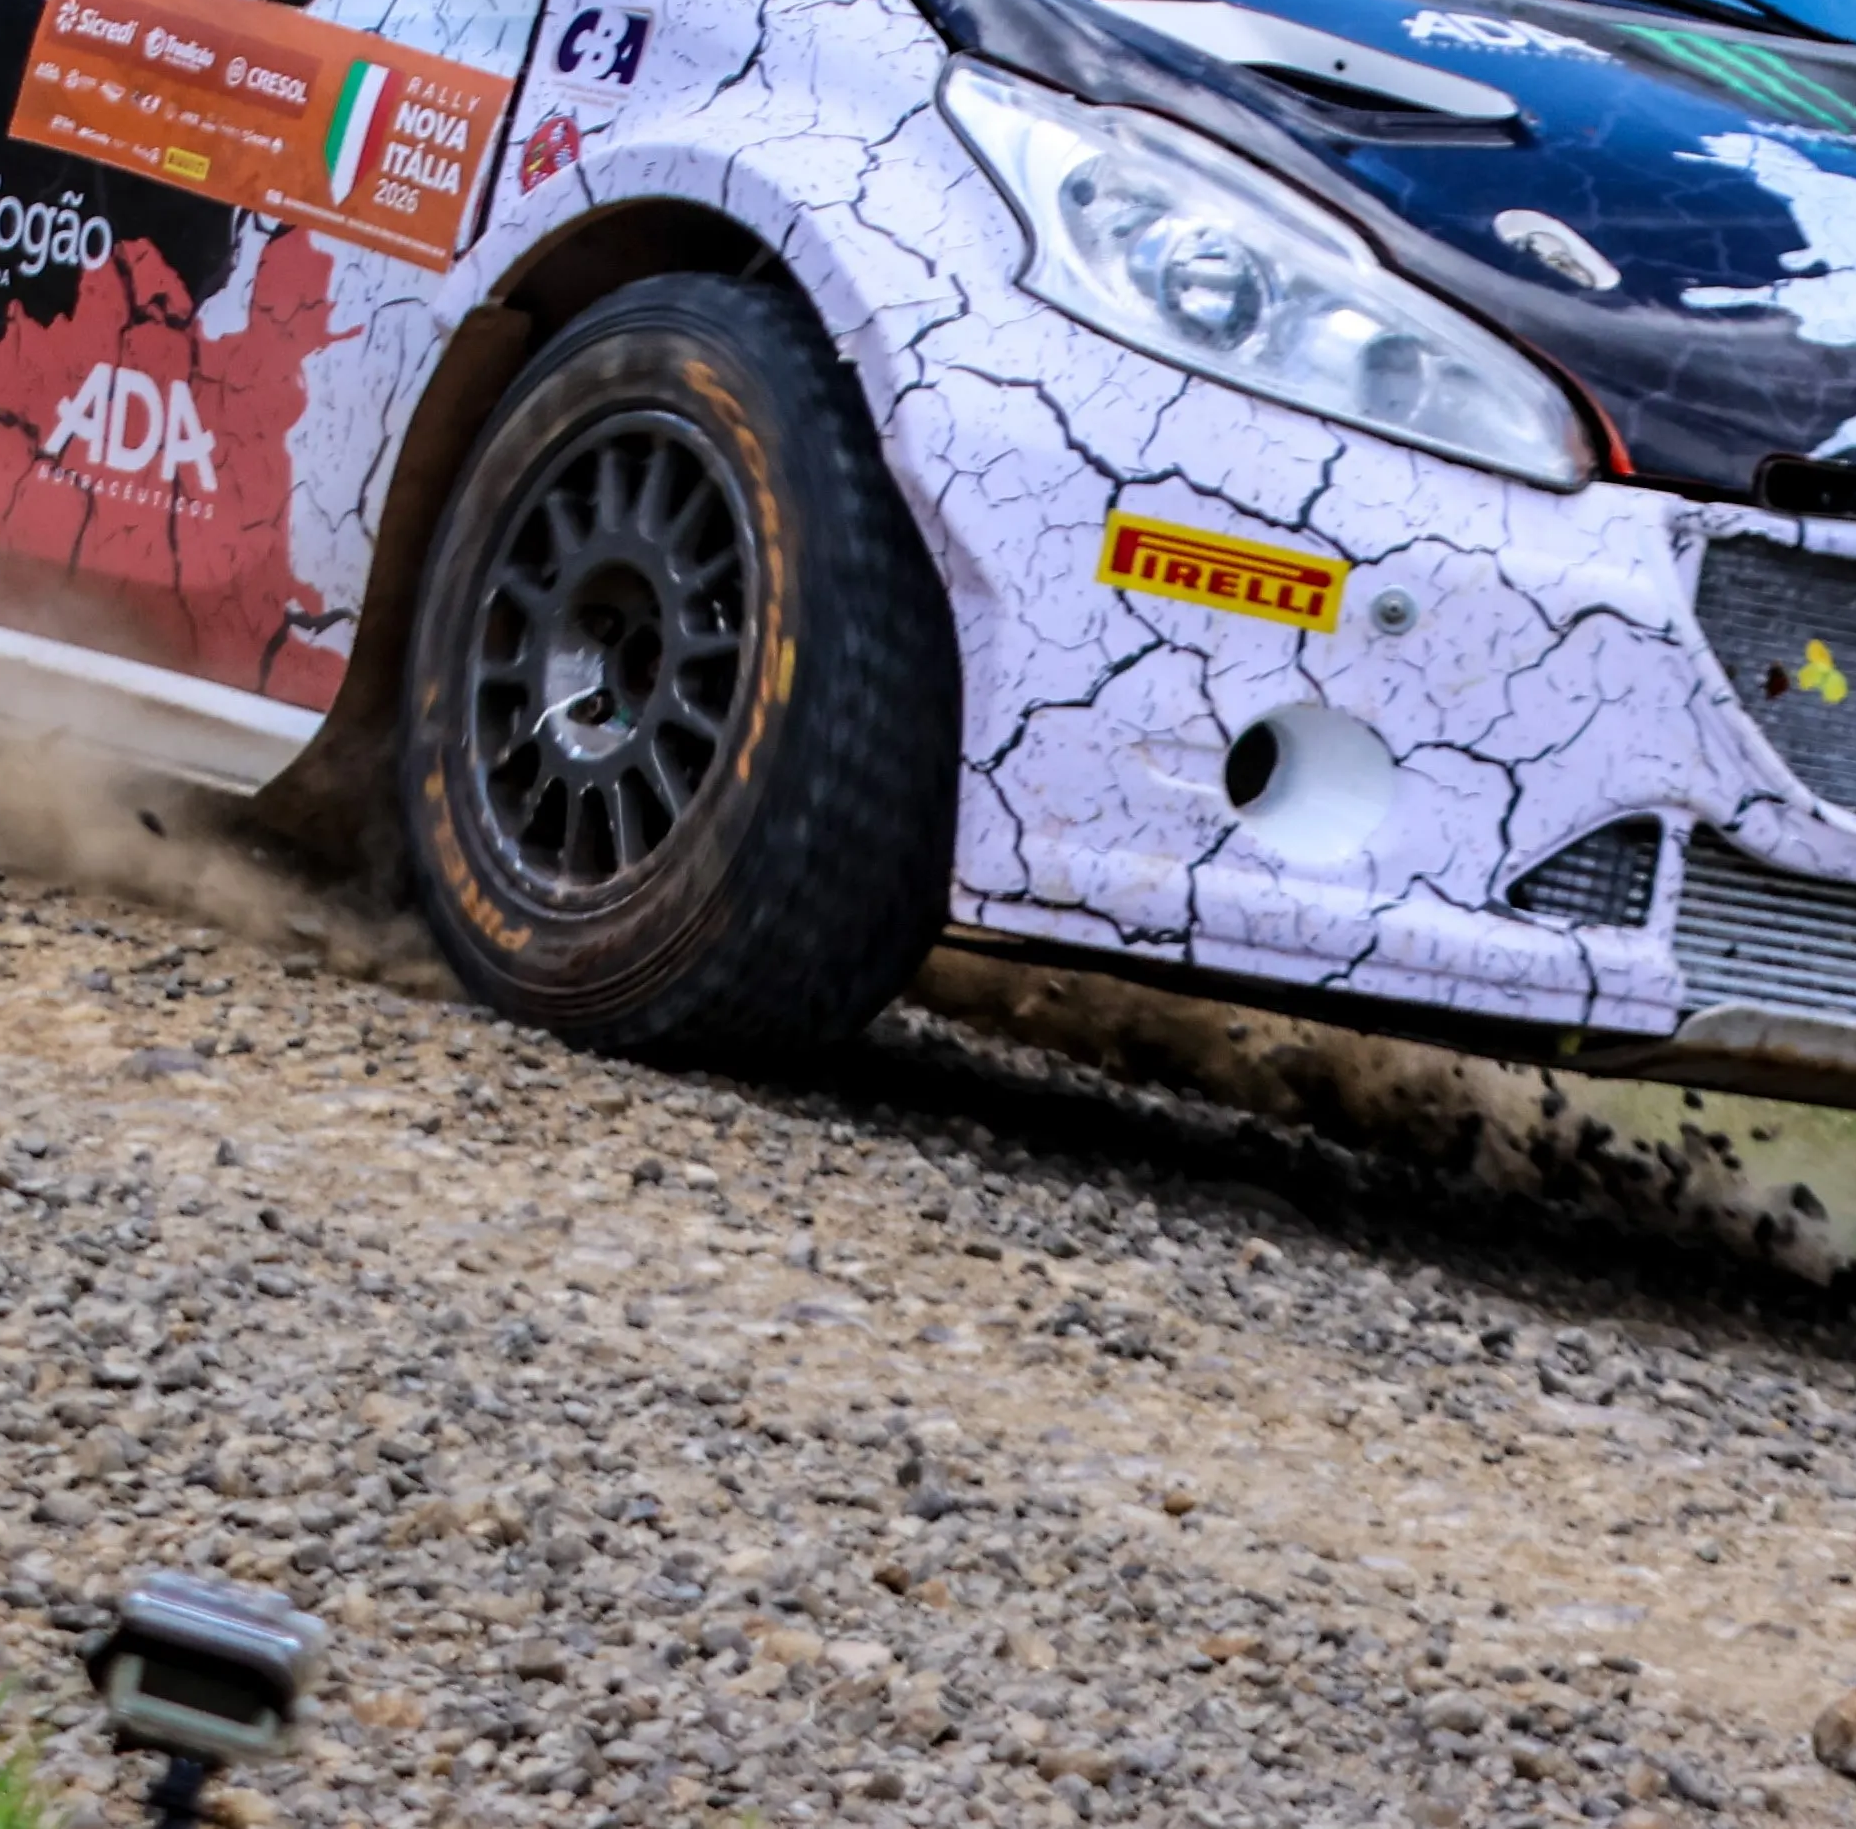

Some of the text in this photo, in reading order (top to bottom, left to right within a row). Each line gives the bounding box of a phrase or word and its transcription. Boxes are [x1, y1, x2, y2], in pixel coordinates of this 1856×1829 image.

[76, 8, 139, 47] Sicredi
[1400, 9, 1612, 58] ADA
[247, 66, 309, 105] CRESOL
[406, 76, 481, 113] RALLY
[394, 100, 470, 153] NOVA
[381, 141, 462, 196] ITÁLIA
[373, 178, 421, 215] 2026
[43, 361, 219, 493] ADA
[1110, 525, 1333, 618] PIRELLI
